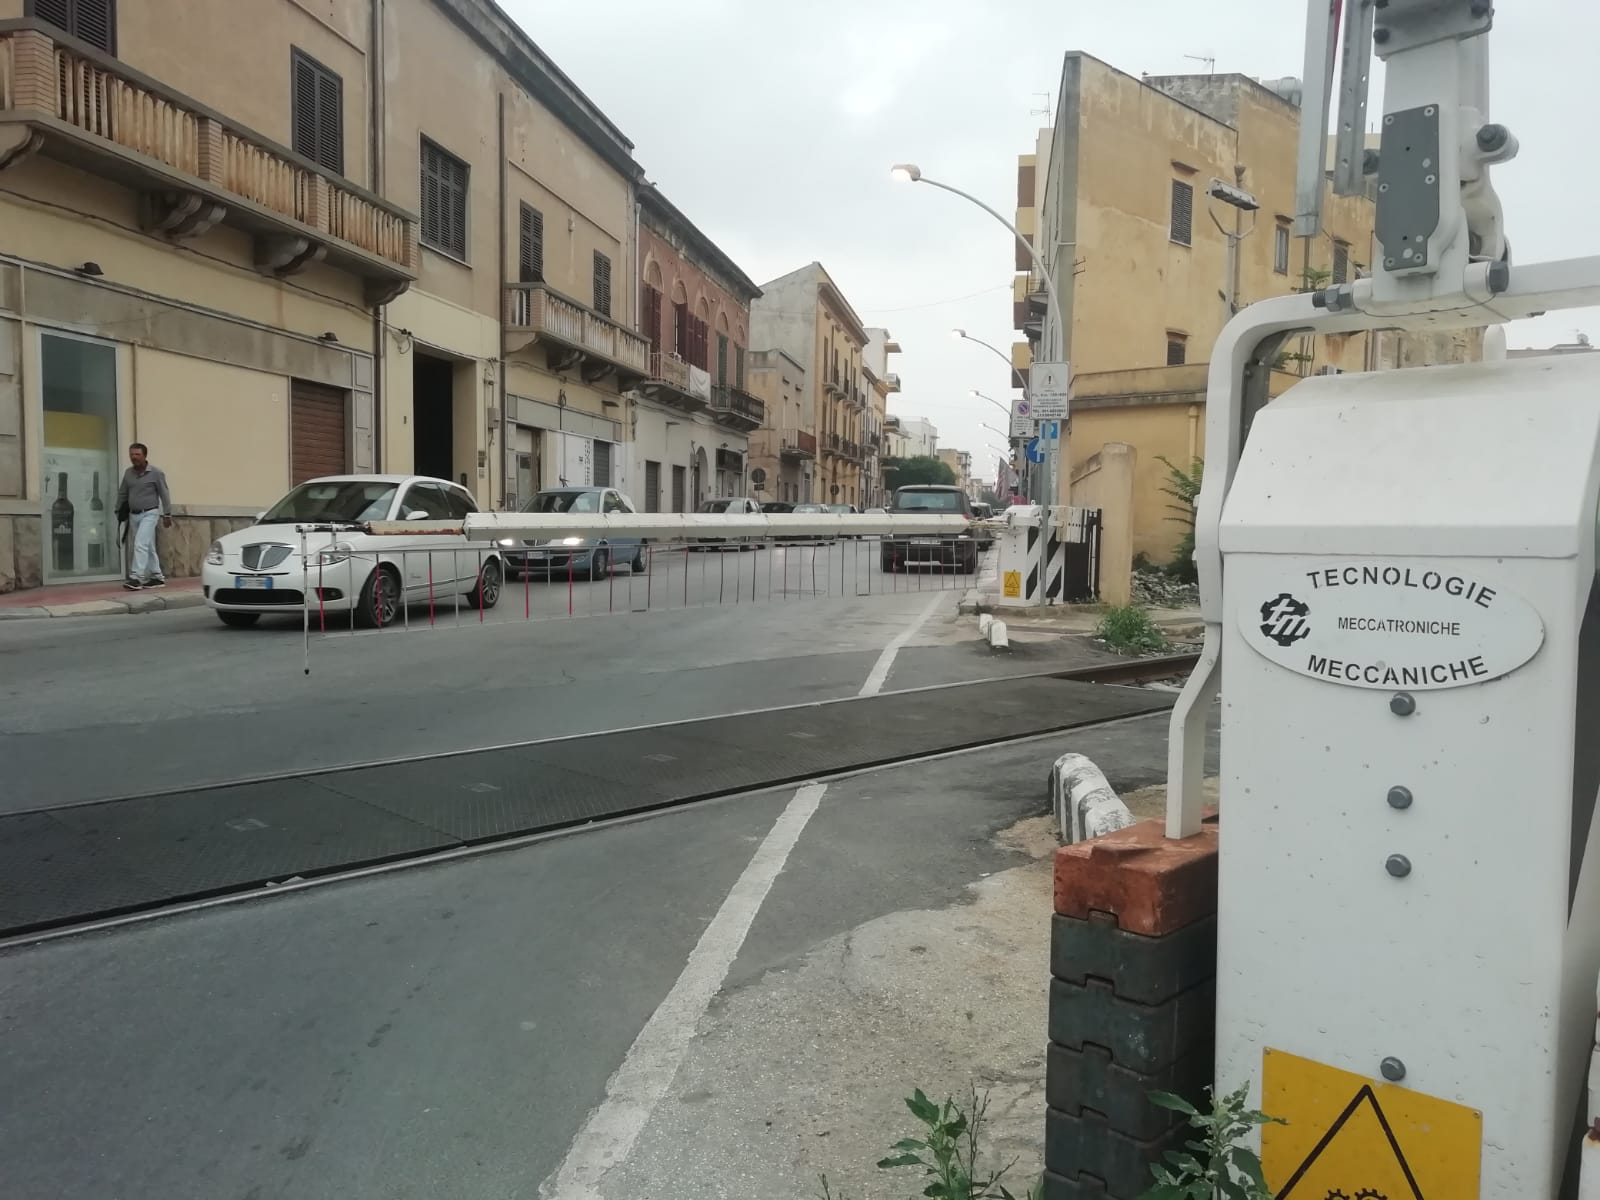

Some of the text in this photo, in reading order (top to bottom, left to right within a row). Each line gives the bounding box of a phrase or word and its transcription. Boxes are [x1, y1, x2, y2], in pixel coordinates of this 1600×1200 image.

[1306, 566, 1496, 608] TECNOLOGIE
[1338, 616, 1461, 636] MECCATRONICHE
[1307, 654, 1489, 685] MECCANICHE
